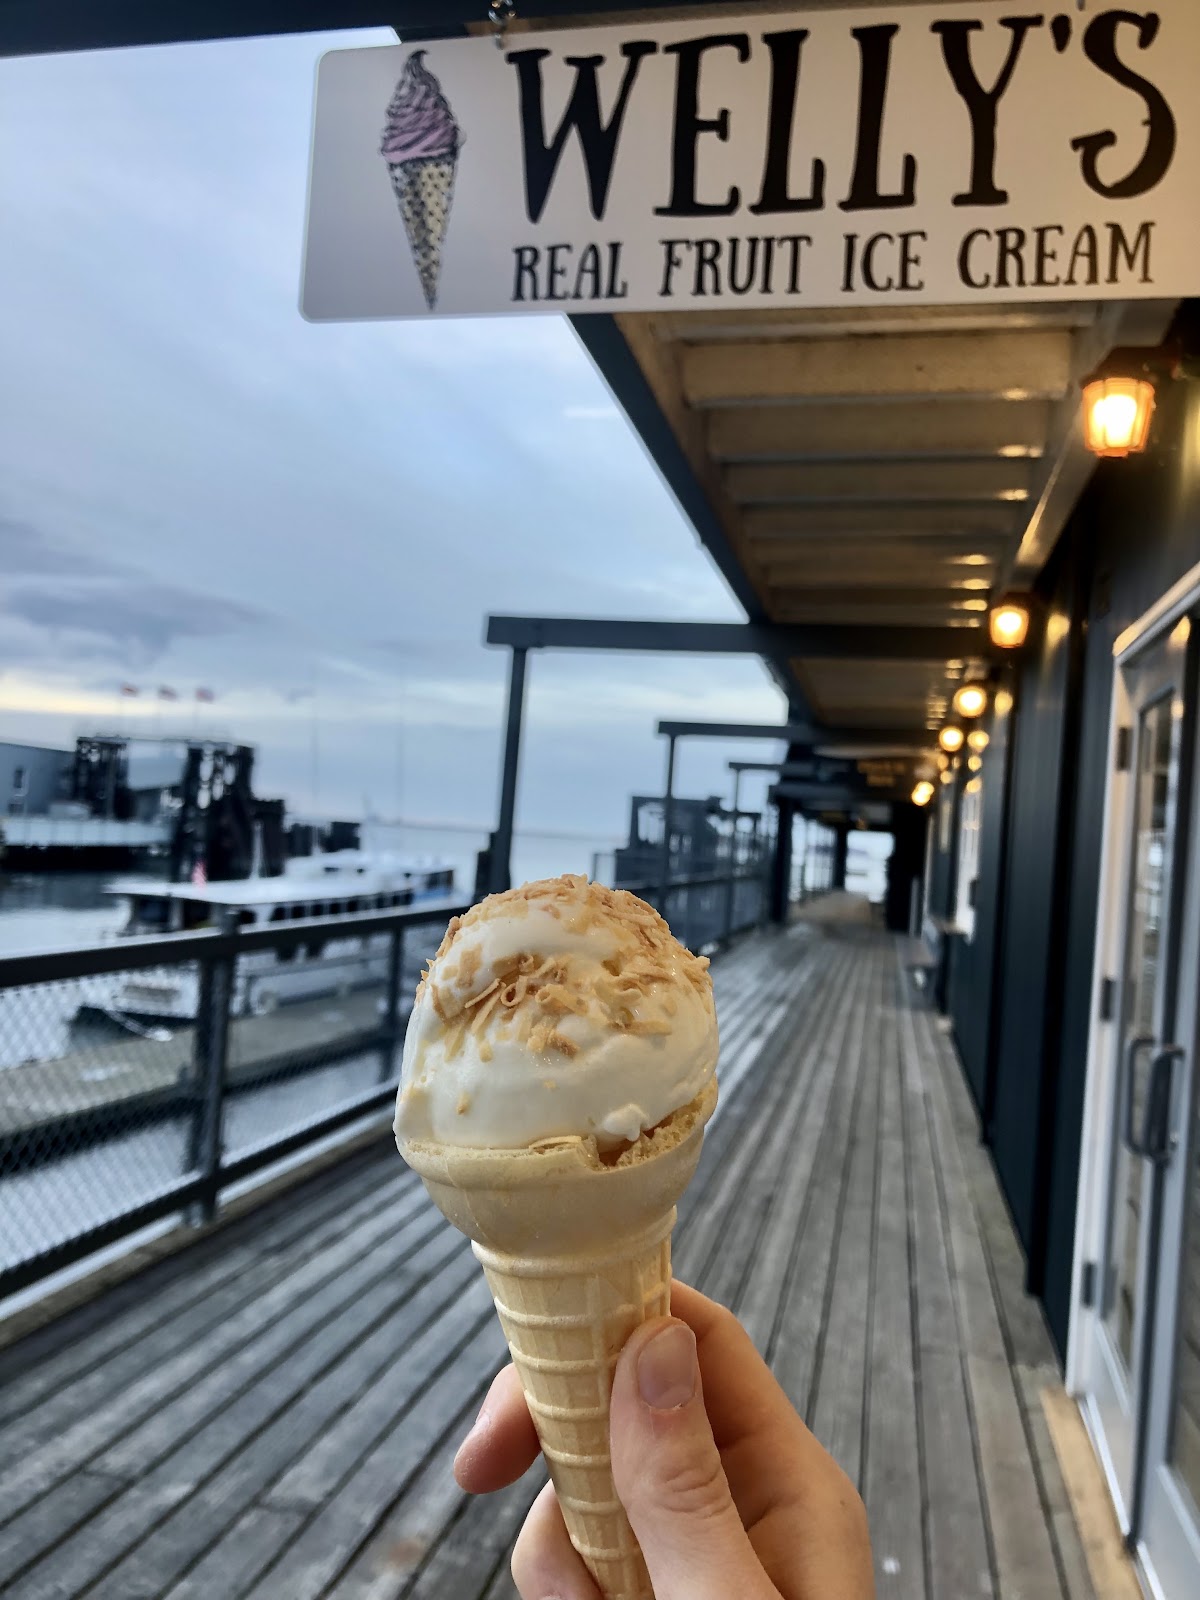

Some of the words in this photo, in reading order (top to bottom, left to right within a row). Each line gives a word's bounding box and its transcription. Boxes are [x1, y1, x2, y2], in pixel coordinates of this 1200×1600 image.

[506, 9, 1177, 223] WELLY'S
[512, 242, 627, 302] REAL
[660, 236, 812, 297] FRUIT
[842, 231, 927, 292] ICE
[957, 222, 1156, 288] CREAM
